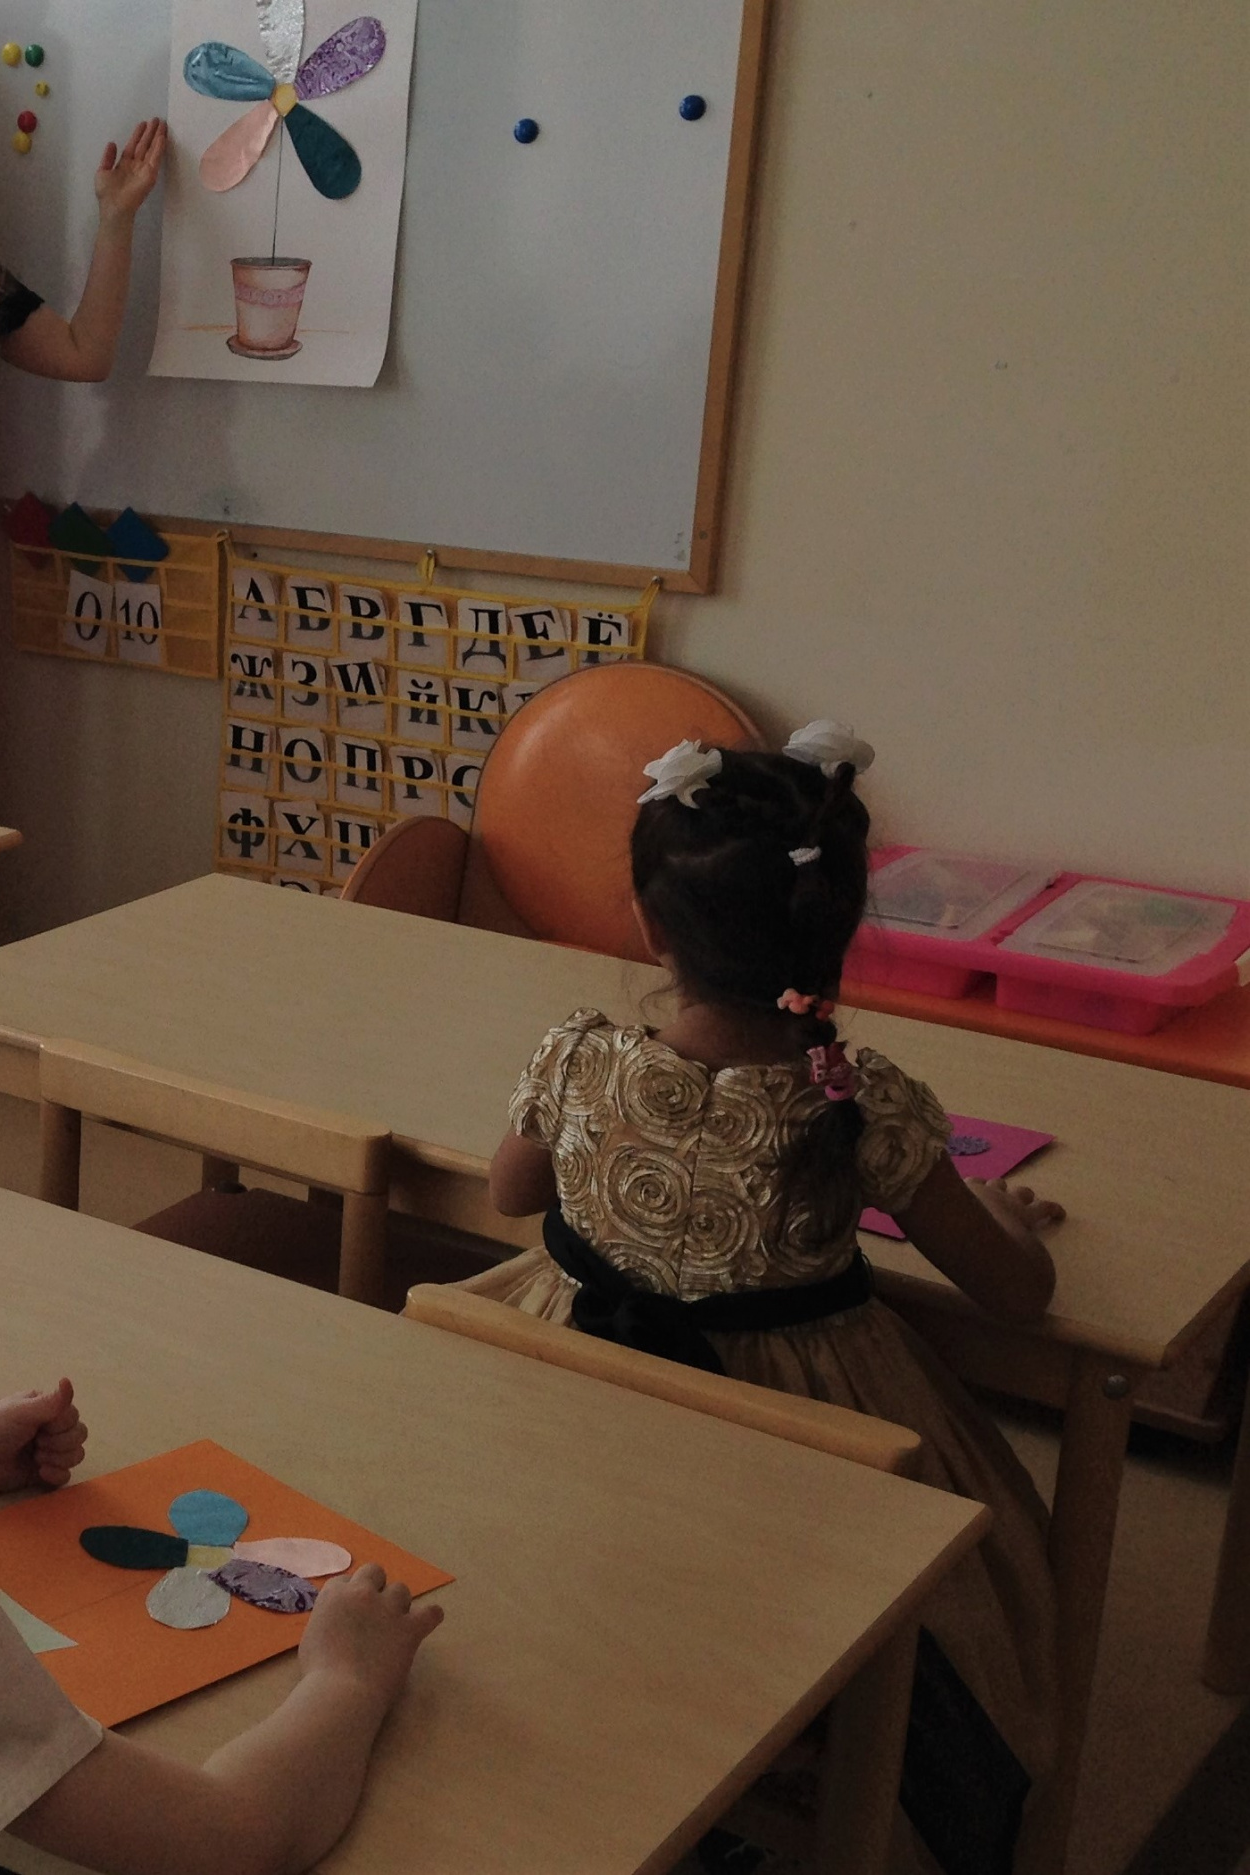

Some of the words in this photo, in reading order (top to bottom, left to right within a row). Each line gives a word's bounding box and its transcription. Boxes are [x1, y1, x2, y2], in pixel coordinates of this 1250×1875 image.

[119, 599, 160, 645] 10
[237, 577, 274, 622] А
[291, 586, 331, 632] Б
[346, 594, 385, 641] В
[404, 601, 444, 648] Г
[462, 607, 507, 669] Д
[515, 610, 566, 661] Е
[583, 612, 622, 663] Ё
[230, 653, 275, 700] Ж
[291, 660, 321, 706] З
[332, 661, 385, 708] И
[452, 686, 498, 735] К
[226, 724, 269, 774] Н
[283, 738, 323, 784] О
[341, 742, 380, 793] П
[397, 754, 434, 800] Р
[227, 807, 267, 858] Ф
[282, 812, 322, 861] Х
